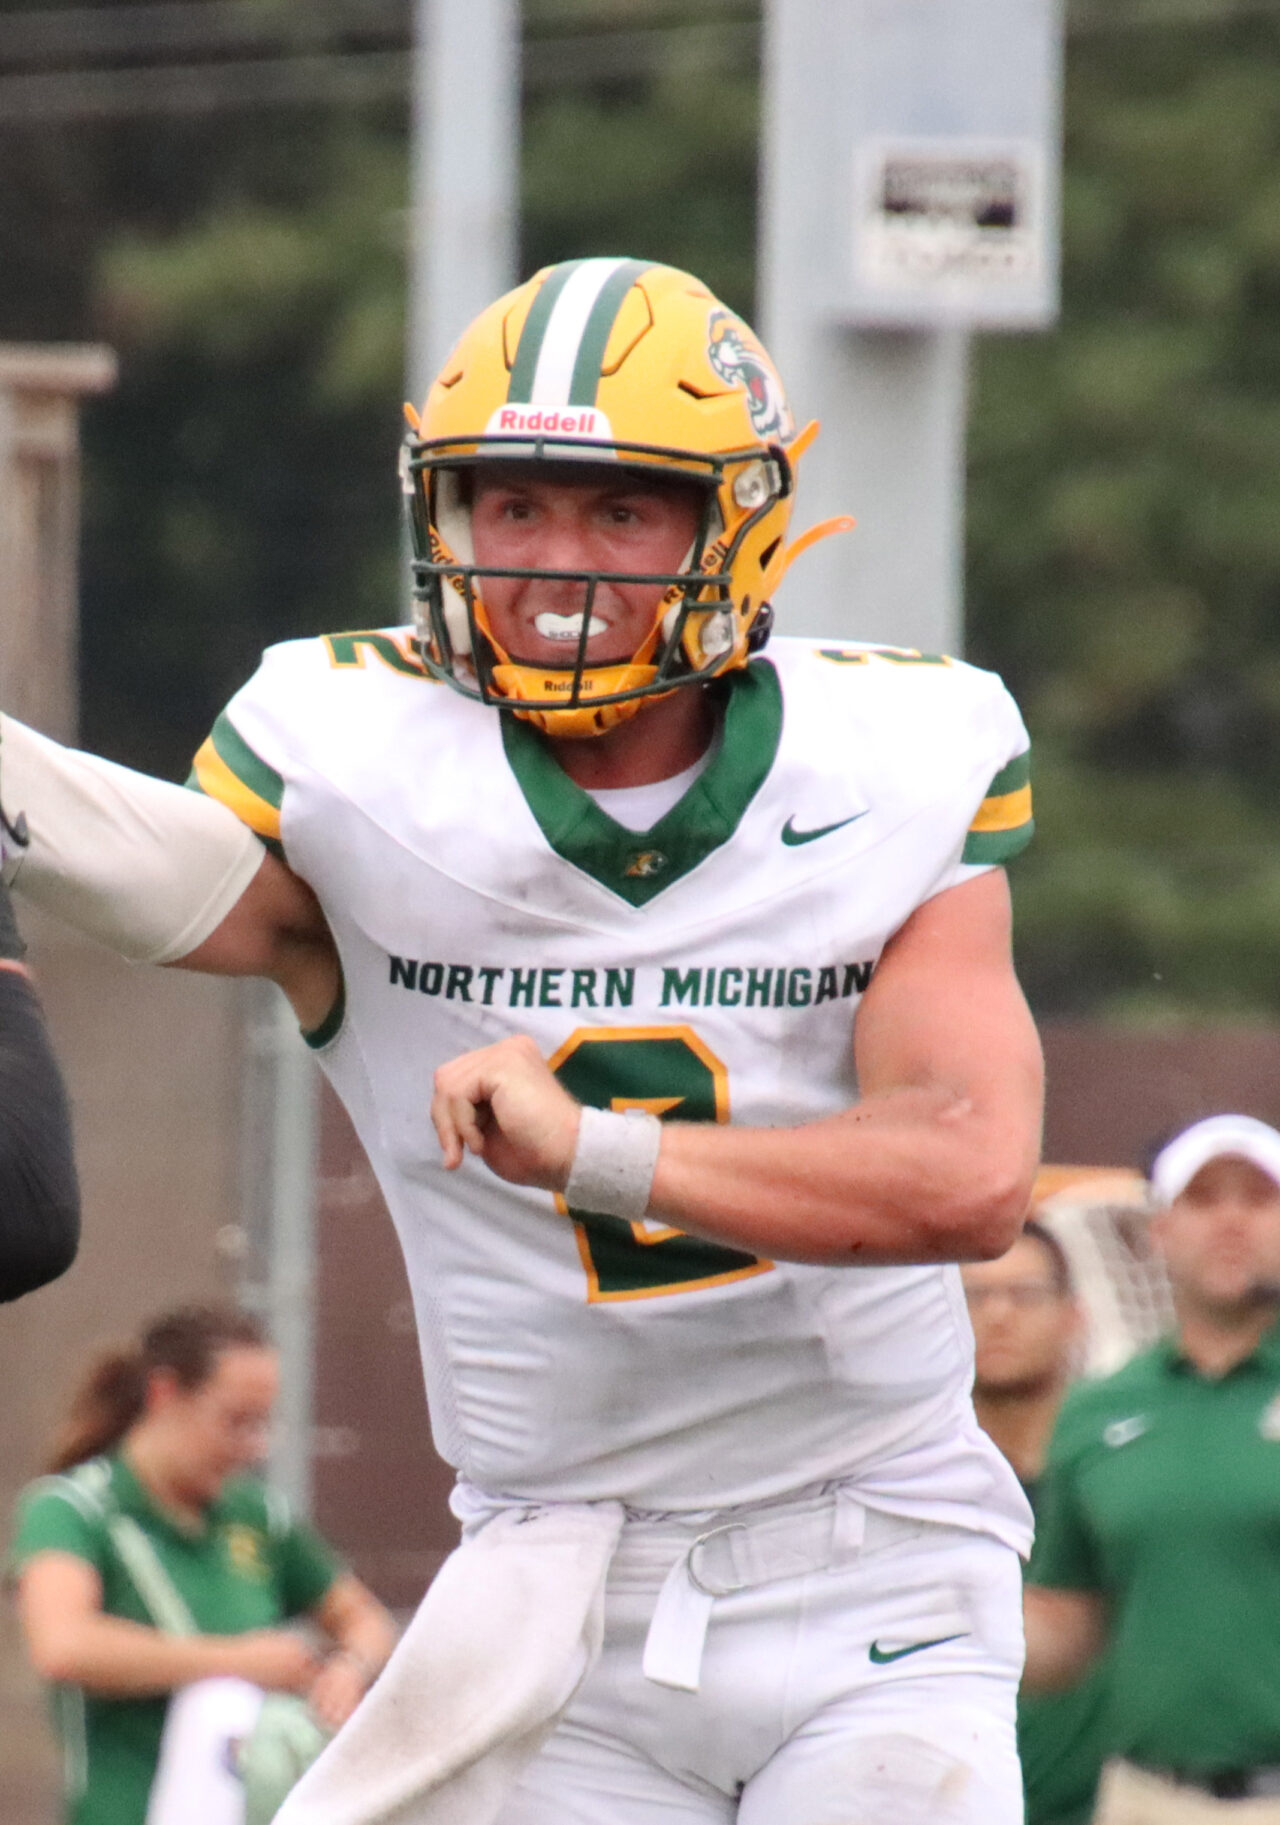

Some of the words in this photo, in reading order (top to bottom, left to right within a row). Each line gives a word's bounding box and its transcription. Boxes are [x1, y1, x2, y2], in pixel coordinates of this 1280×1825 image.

[500, 409, 596, 433] Riddell
[388, 955, 636, 1008] NORTHERN
[658, 960, 875, 1008] MICHIGAN
[545, 1024, 777, 1304] 2
